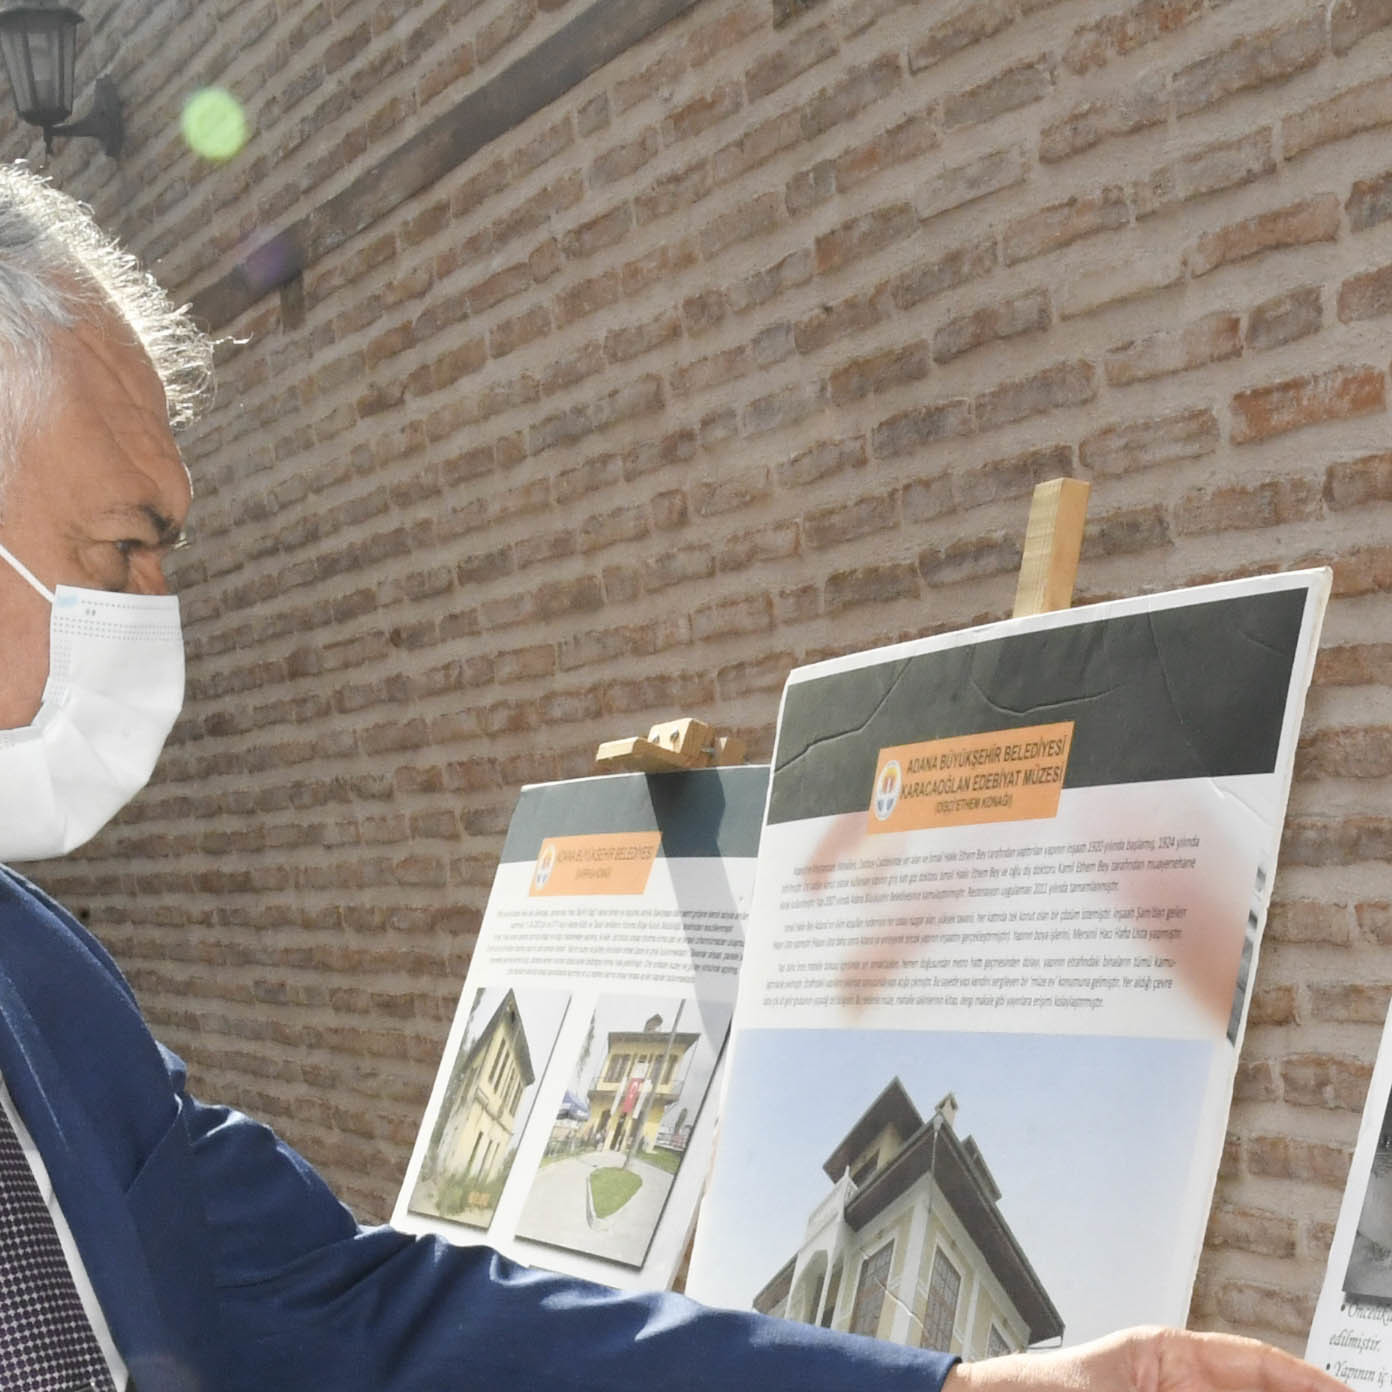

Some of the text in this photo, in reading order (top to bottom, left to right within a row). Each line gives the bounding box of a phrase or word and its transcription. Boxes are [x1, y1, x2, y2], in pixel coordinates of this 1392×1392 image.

[906, 758, 938, 774] ADANA
[1004, 735, 1067, 761] BELEDİYESİ
[971, 768, 1021, 791] EDEBİYAT
